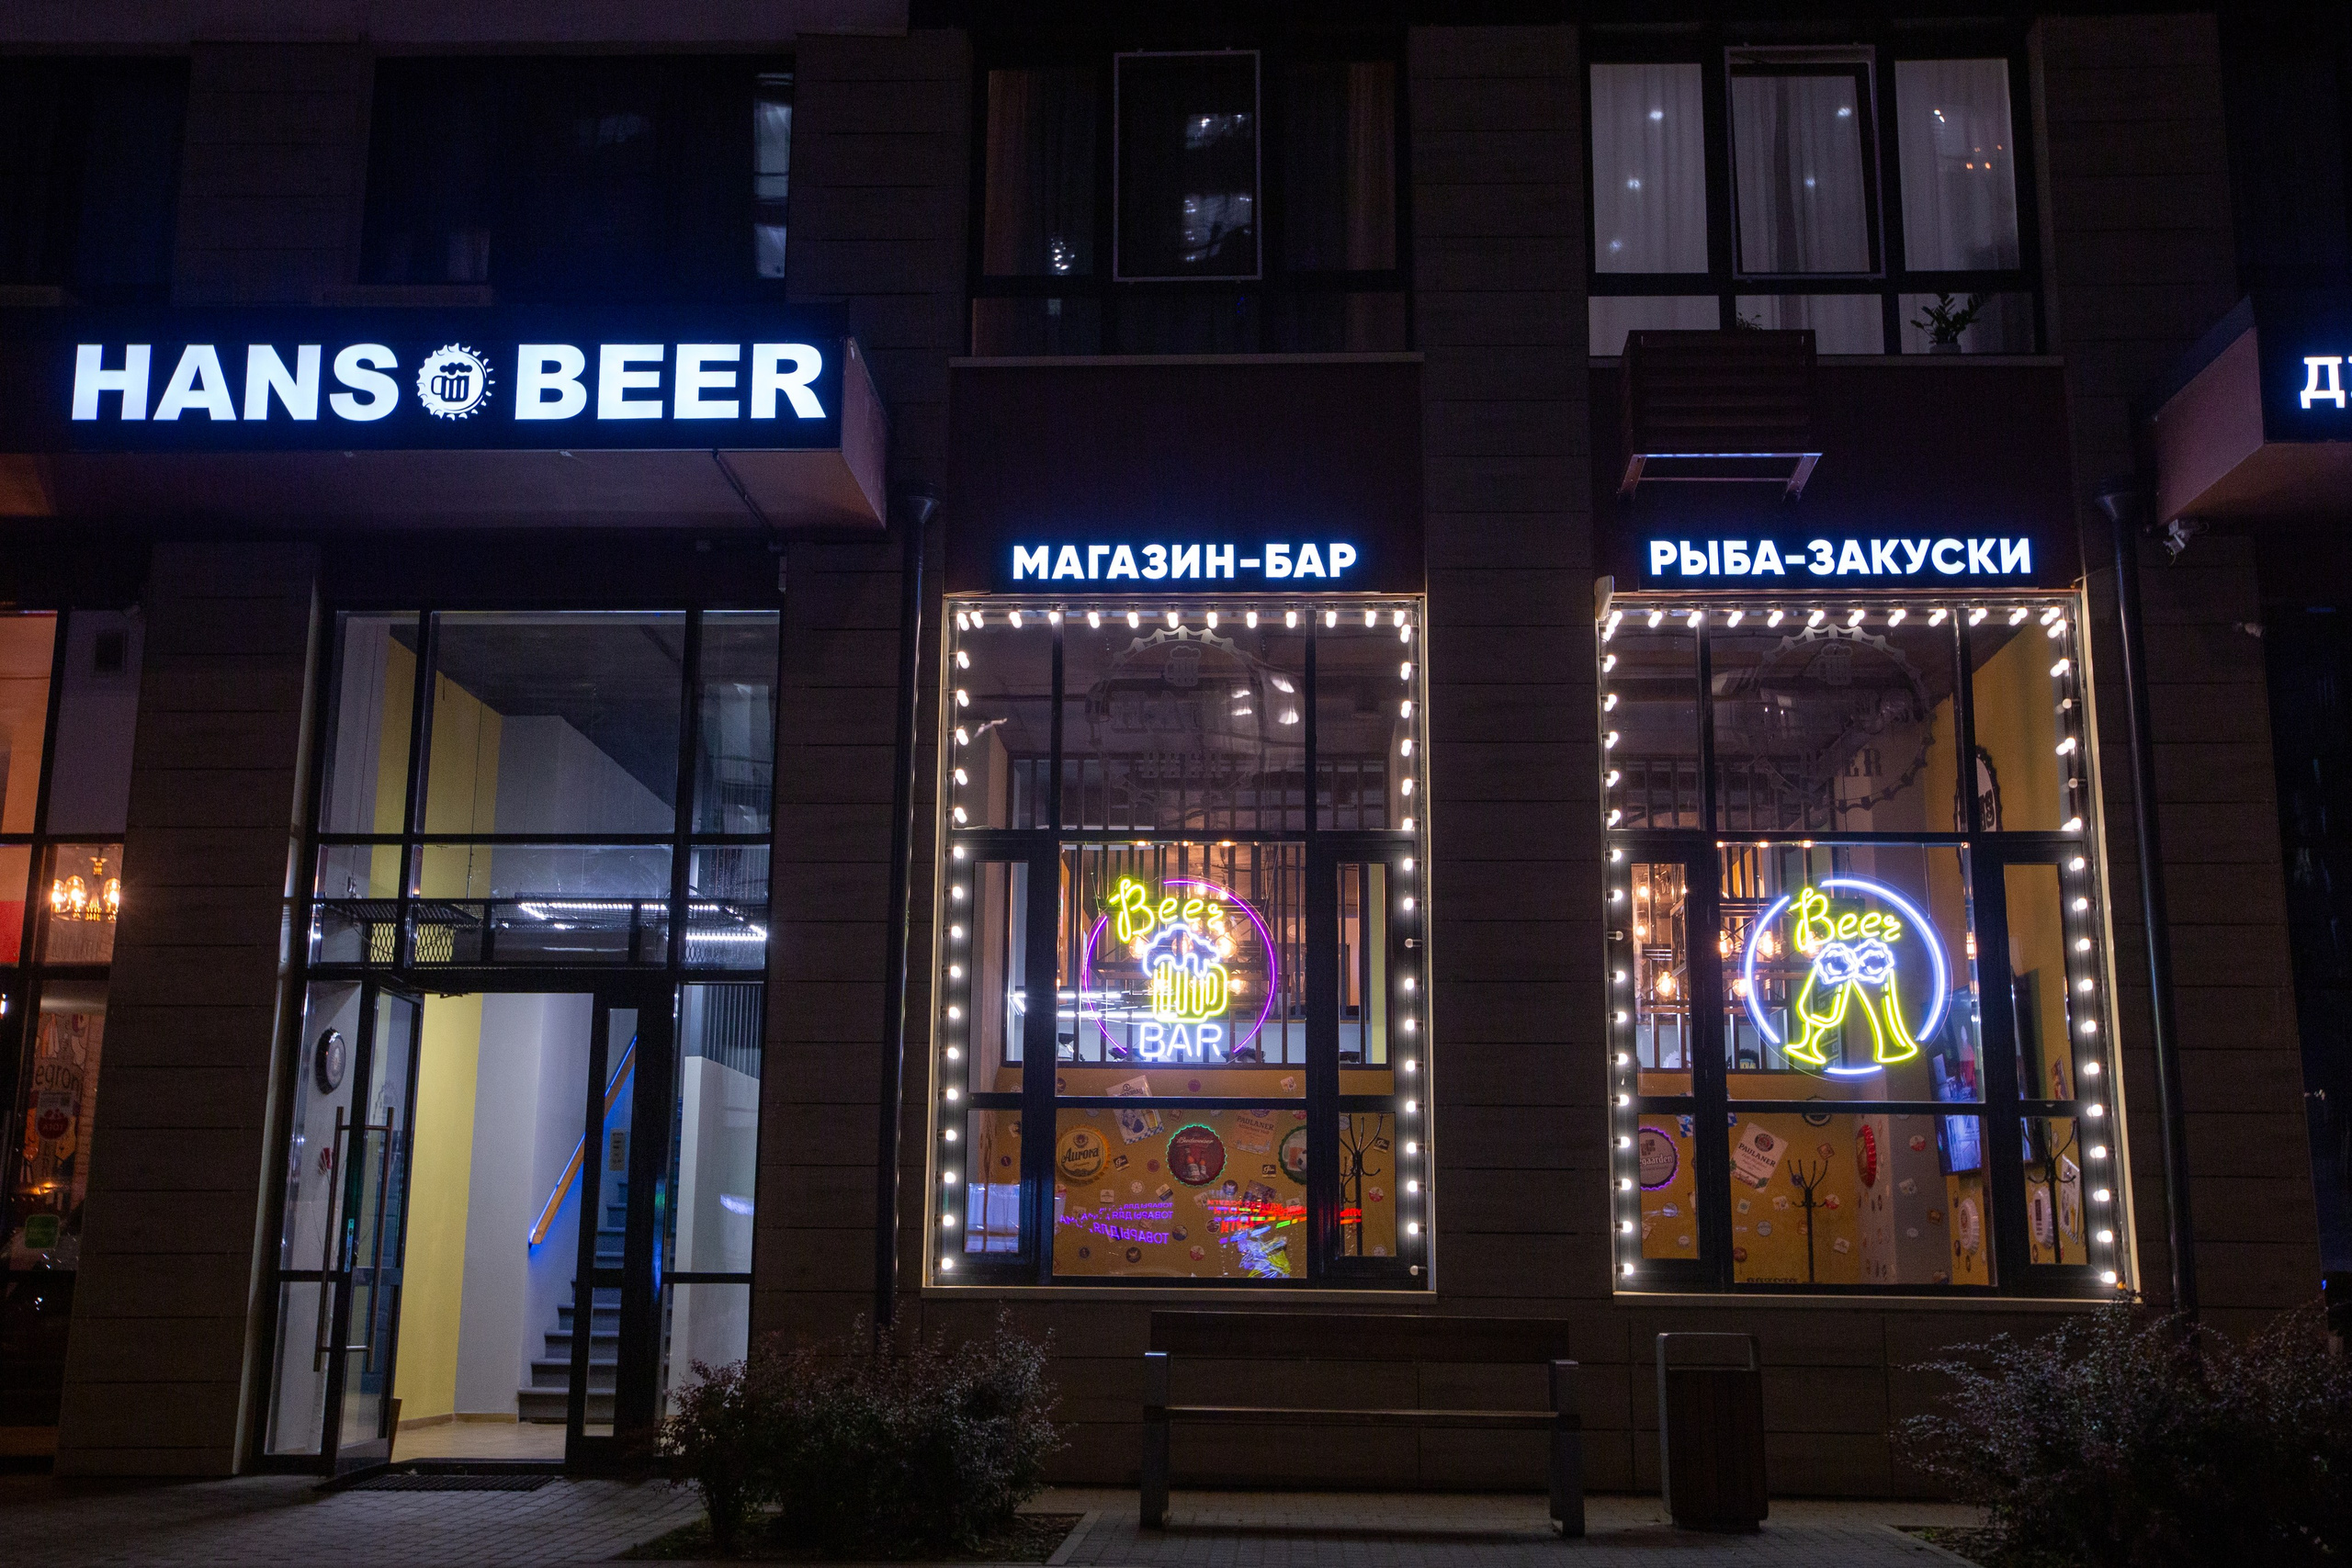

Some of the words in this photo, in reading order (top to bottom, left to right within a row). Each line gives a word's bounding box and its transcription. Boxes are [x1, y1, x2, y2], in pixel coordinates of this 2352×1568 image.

[72, 343, 399, 422] HANS
[514, 344, 826, 420] BEER
[2300, 355, 2352, 410] Д
[1013, 543, 1357, 580] МАГАЗИН-БАР
[1650, 538, 2031, 576] РЫБА-ЗАКУСКИ
[1109, 878, 1224, 943] Beer
[1788, 887, 1902, 952] Beer
[1139, 1022, 1222, 1057] BAR
[1237, 1115, 1274, 1131] PAULANER
[1061, 1147, 1099, 1164] Aurora
[1738, 1143, 1776, 1168] PAULANER
